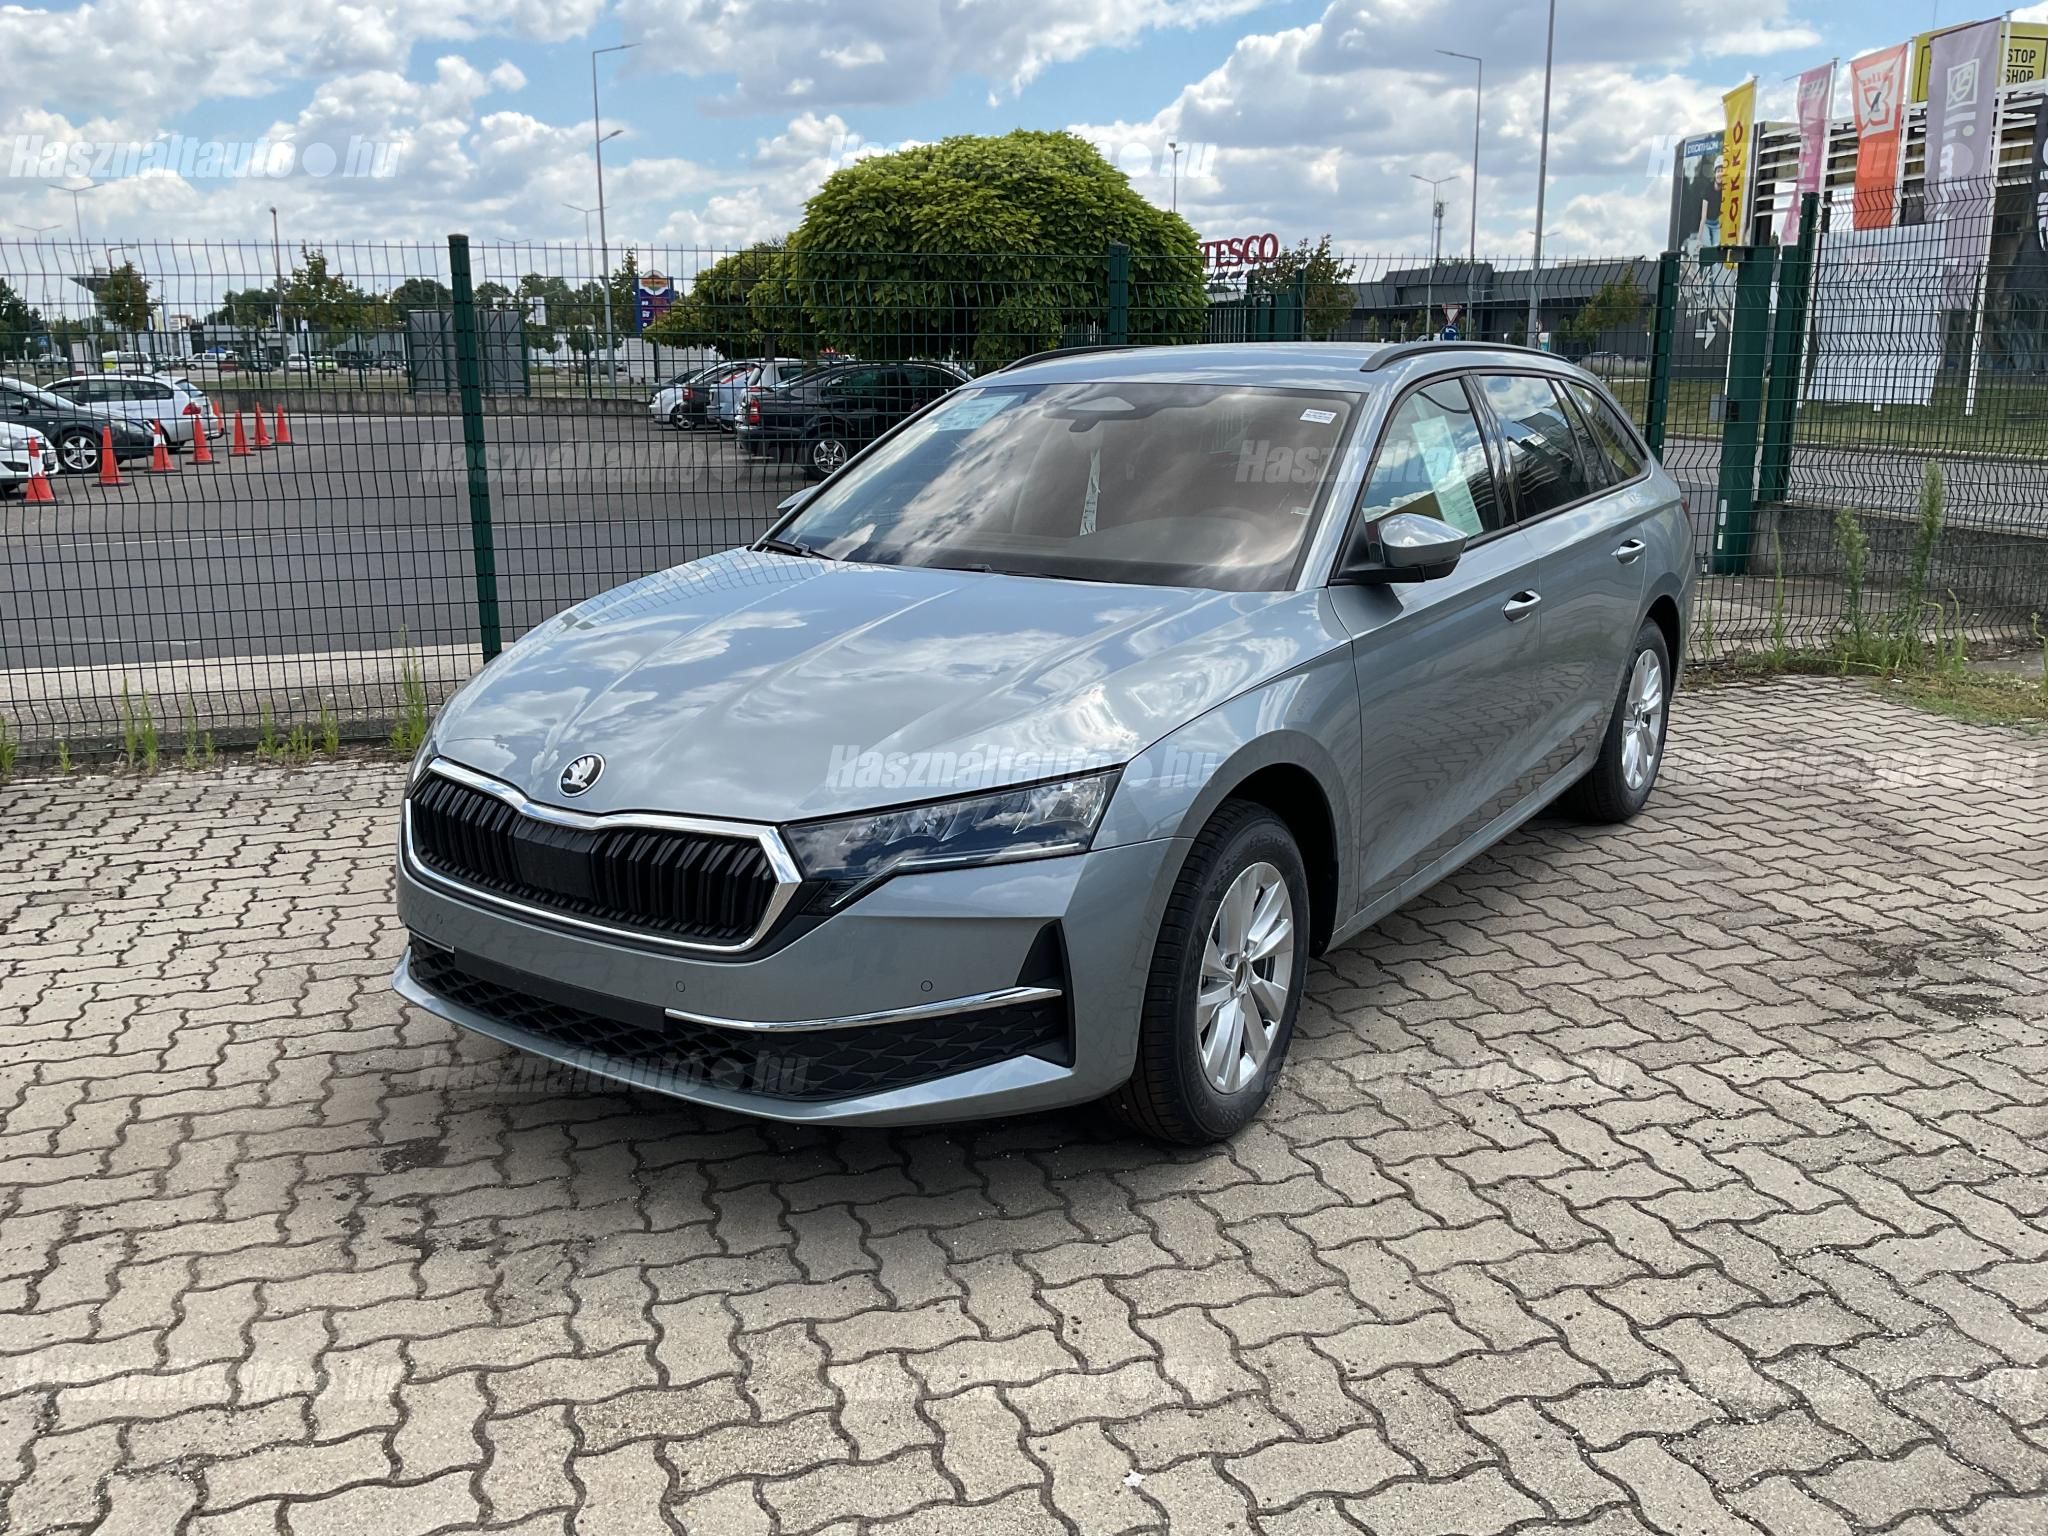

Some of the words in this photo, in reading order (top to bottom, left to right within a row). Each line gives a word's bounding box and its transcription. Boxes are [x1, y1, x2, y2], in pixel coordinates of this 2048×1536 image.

[2007, 48, 2036, 63] STOP
[2005, 69, 2034, 83] SHOP
[1200, 233, 1279, 268] TESCO
